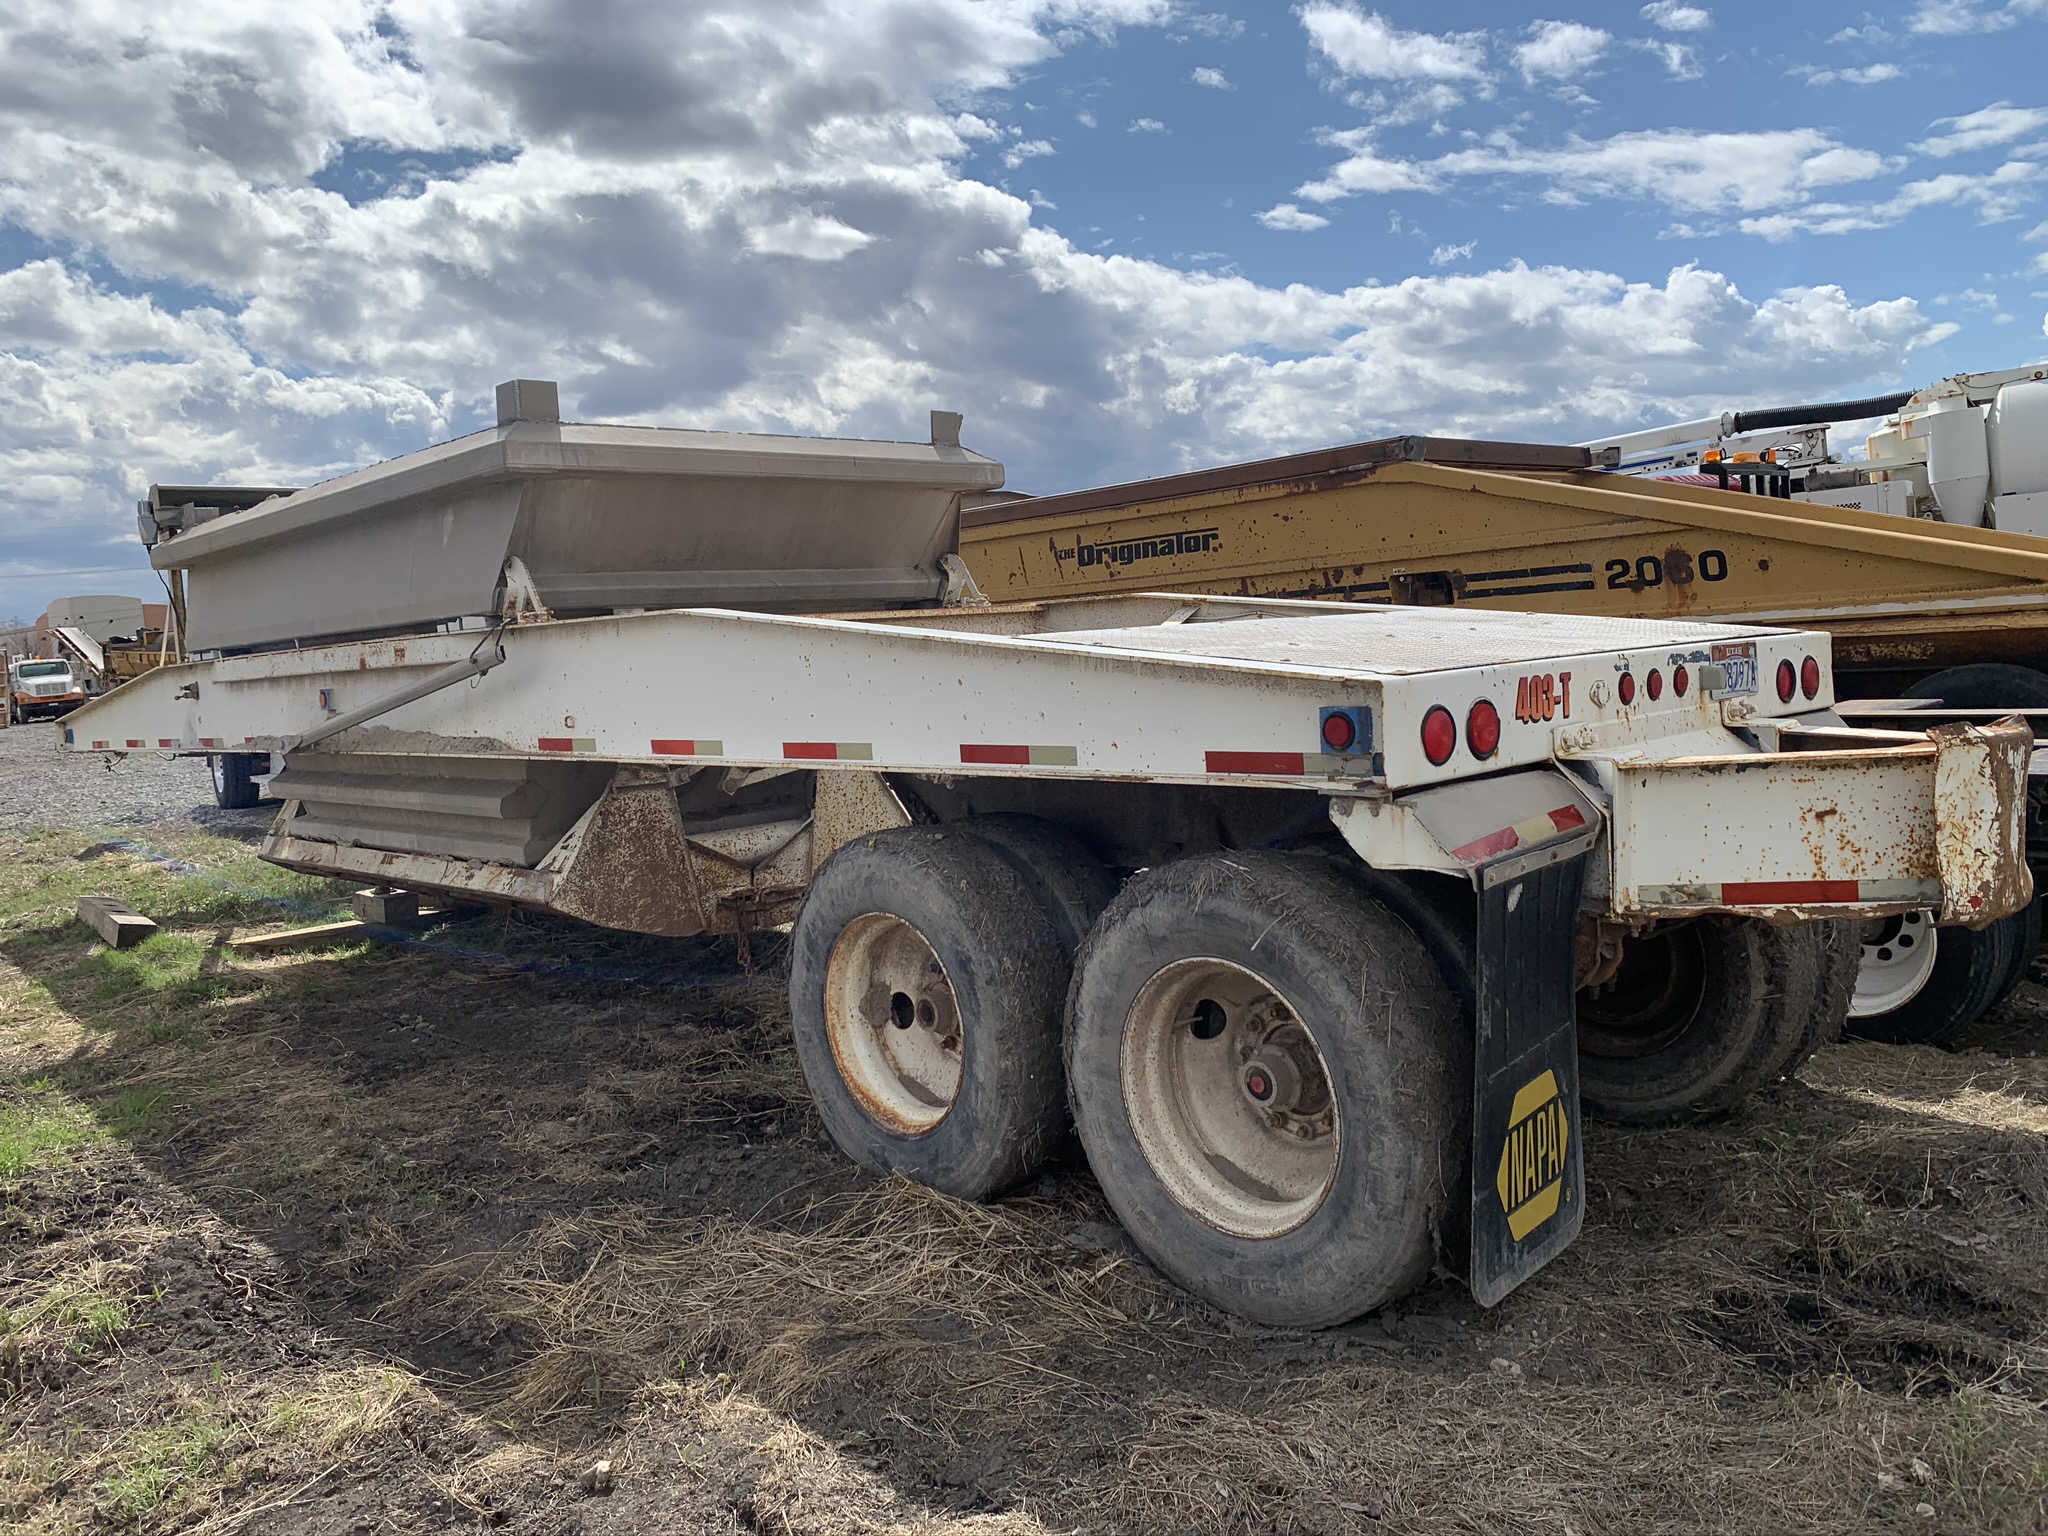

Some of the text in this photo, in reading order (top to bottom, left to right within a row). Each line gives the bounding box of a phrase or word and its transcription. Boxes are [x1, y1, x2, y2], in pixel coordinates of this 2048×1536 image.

[1058, 548, 1076, 560] THE
[1726, 646, 1743, 656] UTAH
[1515, 671, 1571, 725] 403-T
[1511, 1103, 1560, 1209] NAPA
